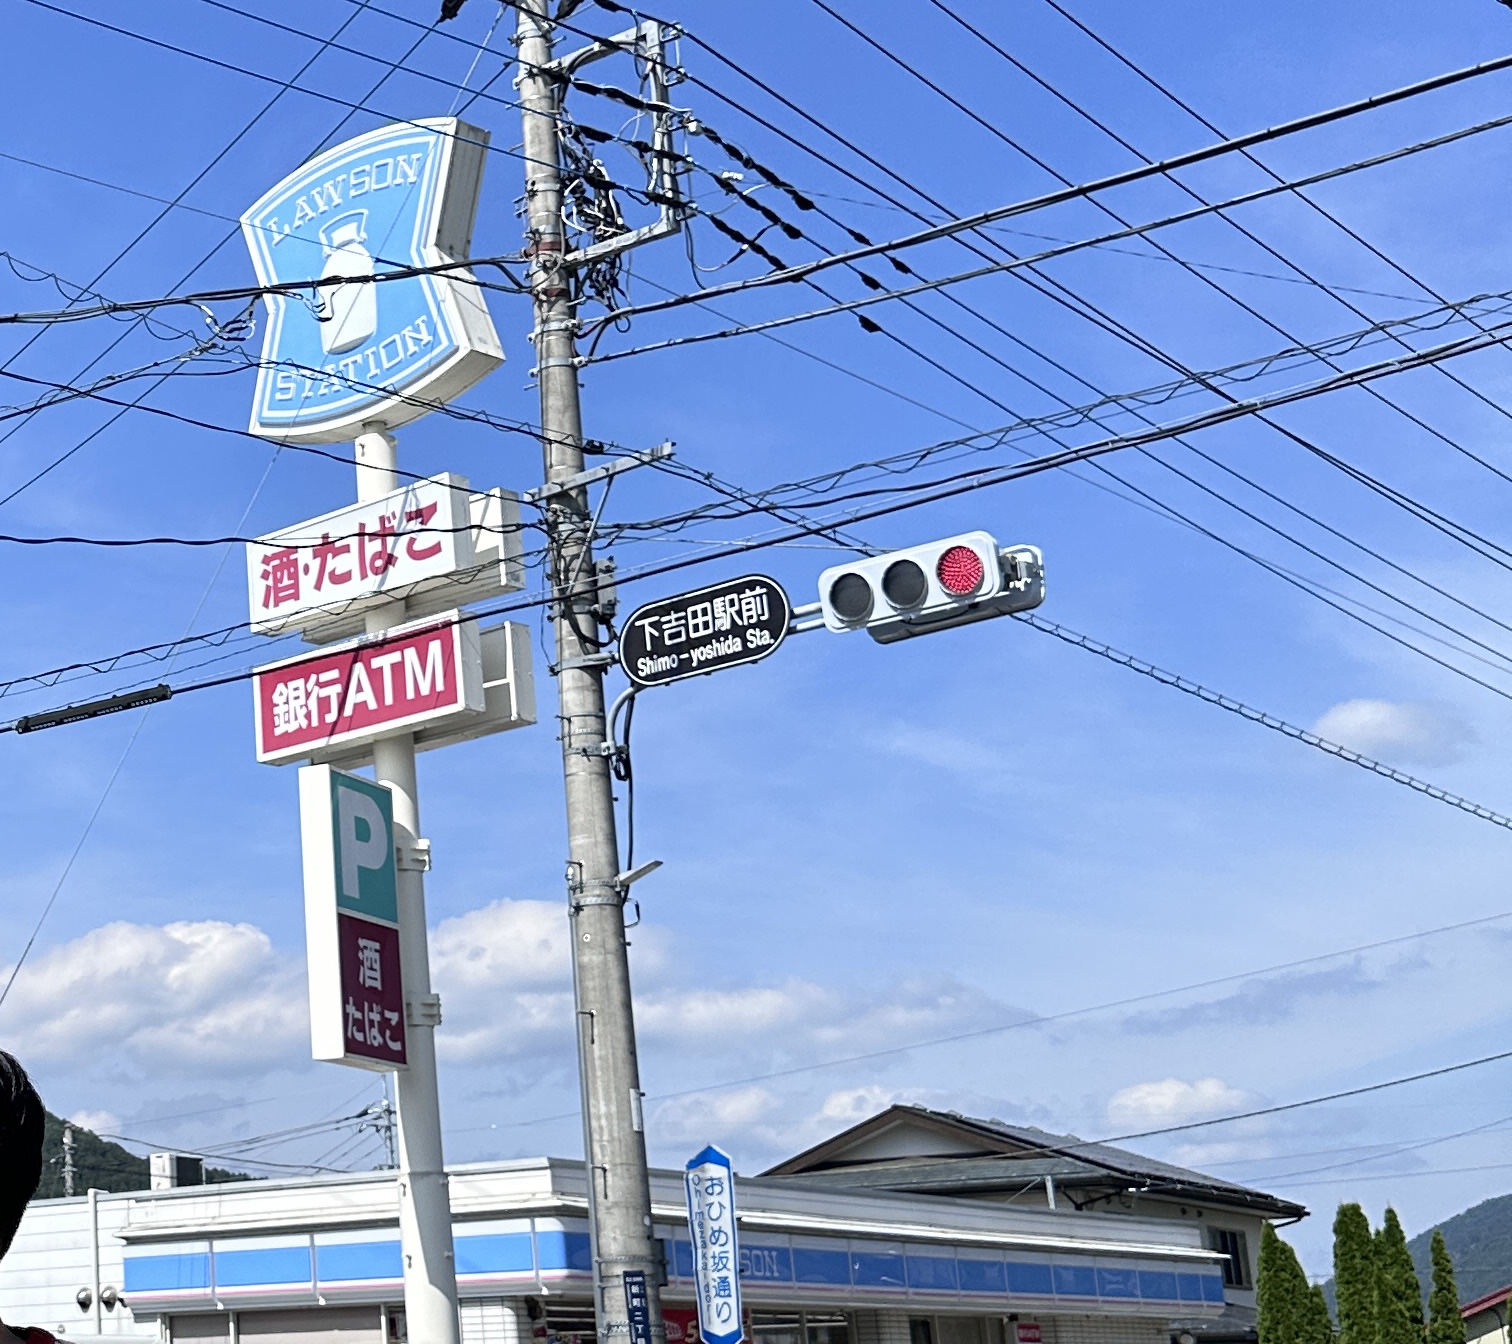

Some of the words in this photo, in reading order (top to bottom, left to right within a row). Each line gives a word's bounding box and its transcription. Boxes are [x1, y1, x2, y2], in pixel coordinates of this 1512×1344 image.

[267, 154, 423, 247] LAWSON
[274, 315, 434, 401] STATION
[635, 586, 769, 651] 下吉田駅前
[637, 635, 743, 677] Shimo-yoshida
[746, 628, 774, 648] Sta.
[272, 639, 444, 737] 銀行ATM
[338, 785, 388, 899] P
[357, 936, 383, 991] 酒
[345, 996, 402, 1051] たばこ
[704, 1176, 733, 1324] おひめ坂通り
